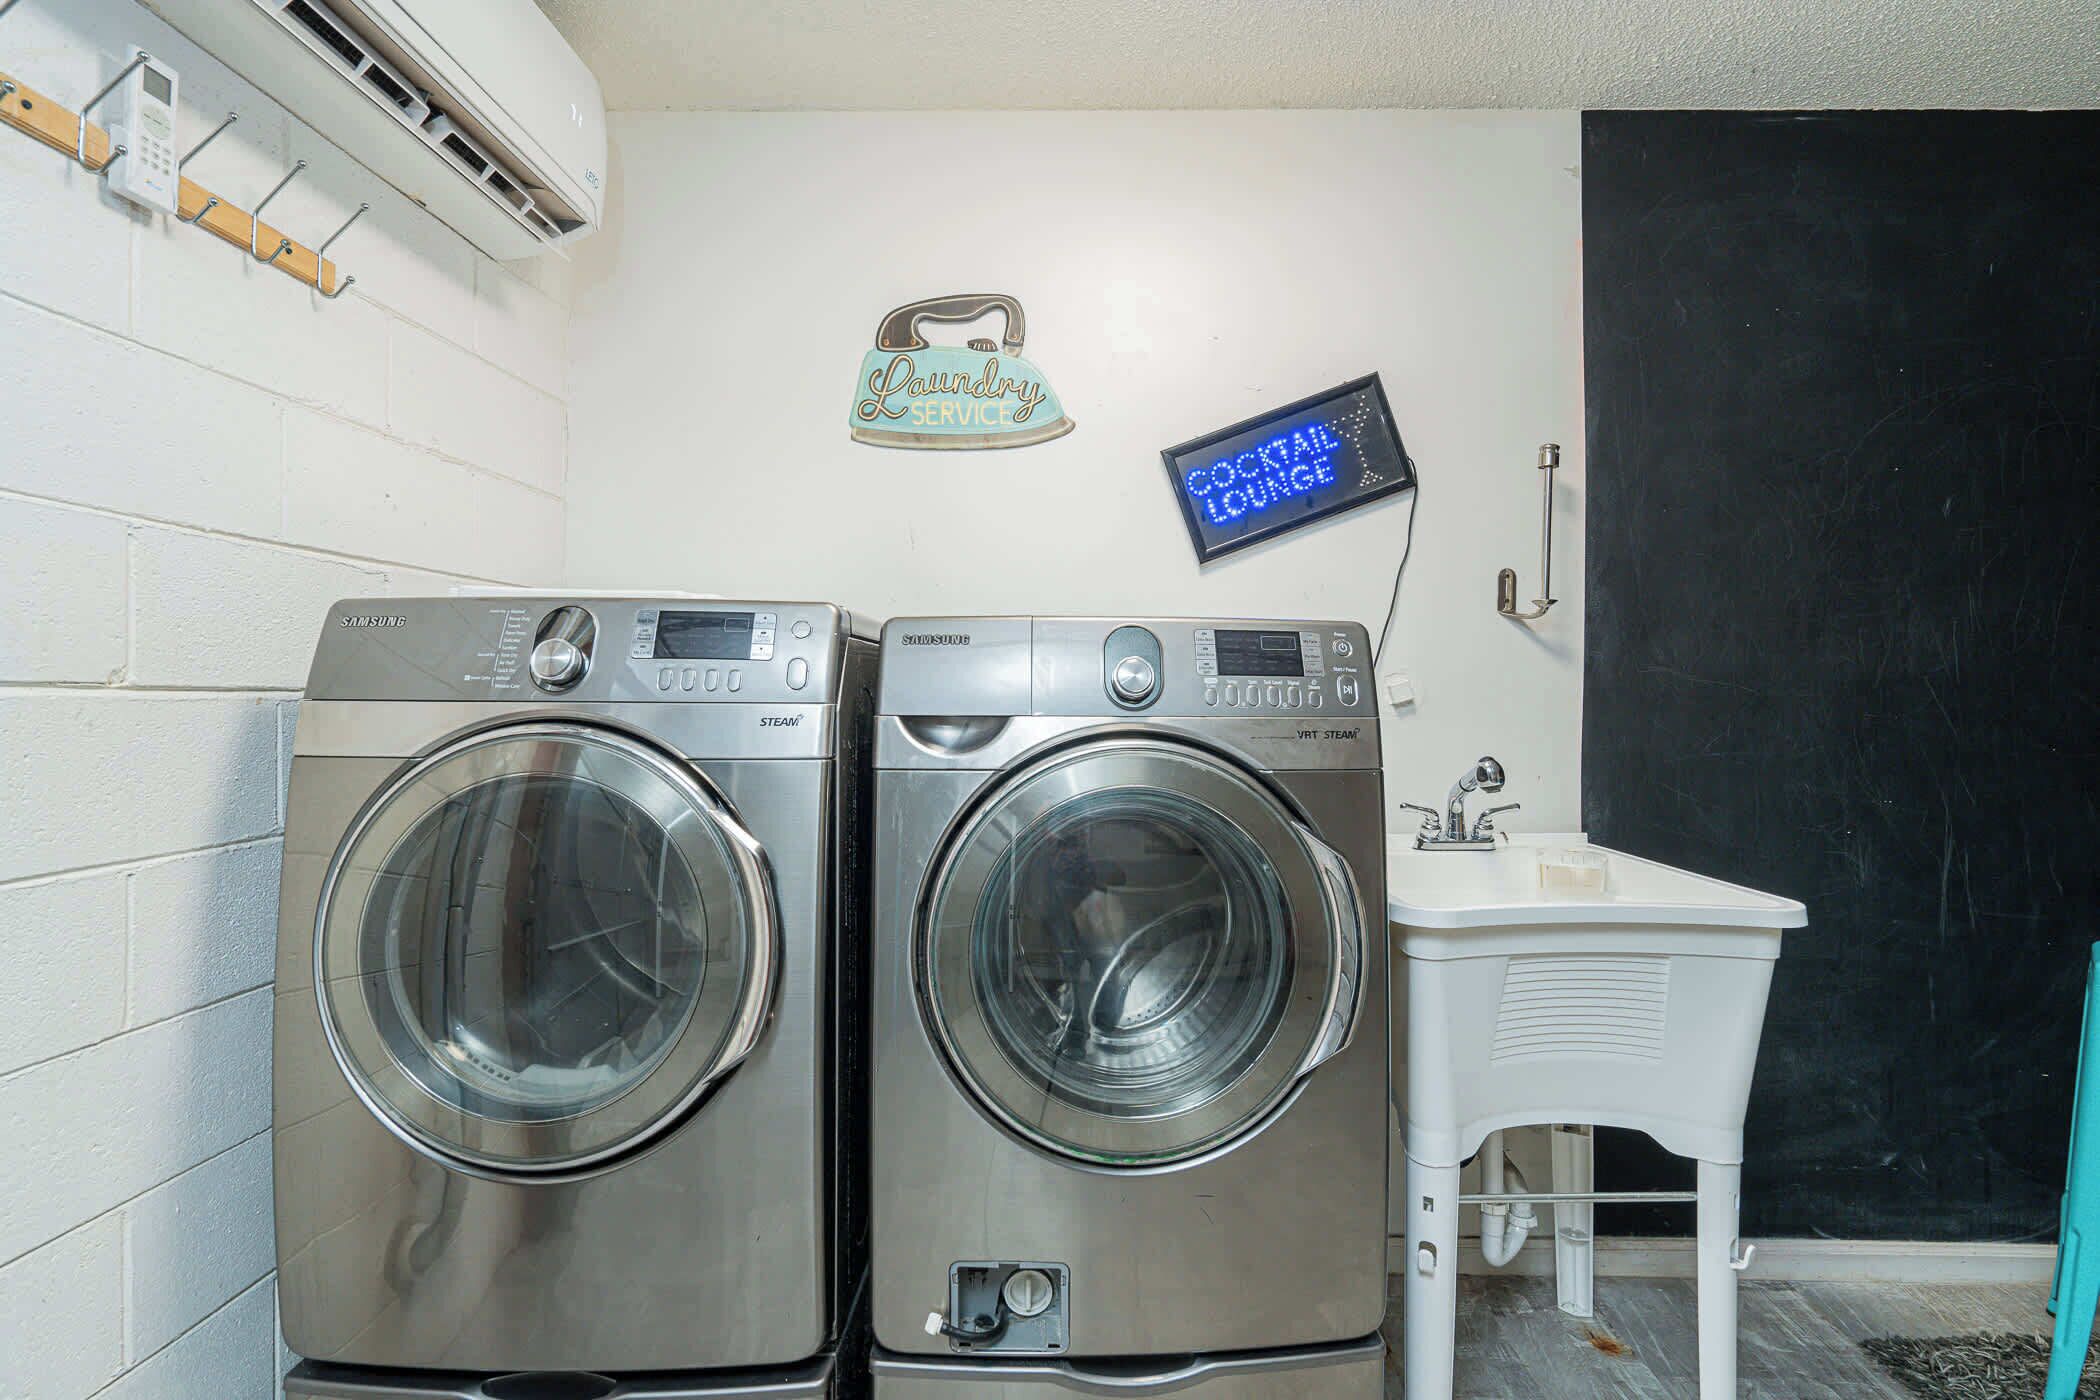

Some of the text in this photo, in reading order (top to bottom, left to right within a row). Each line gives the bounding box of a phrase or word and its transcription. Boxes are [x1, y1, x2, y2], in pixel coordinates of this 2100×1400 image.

[857, 353, 1047, 424] Laundry
[911, 399, 1015, 426] SERVICE
[1187, 424, 1339, 496] COCKTAIL
[1207, 456, 1335, 525] LOUNGE
[340, 615, 407, 627] SAMSUNG
[902, 633, 970, 645] SAMSUNG
[759, 717, 799, 727] STEAM
[1297, 730, 1358, 740] VRT STEAM
